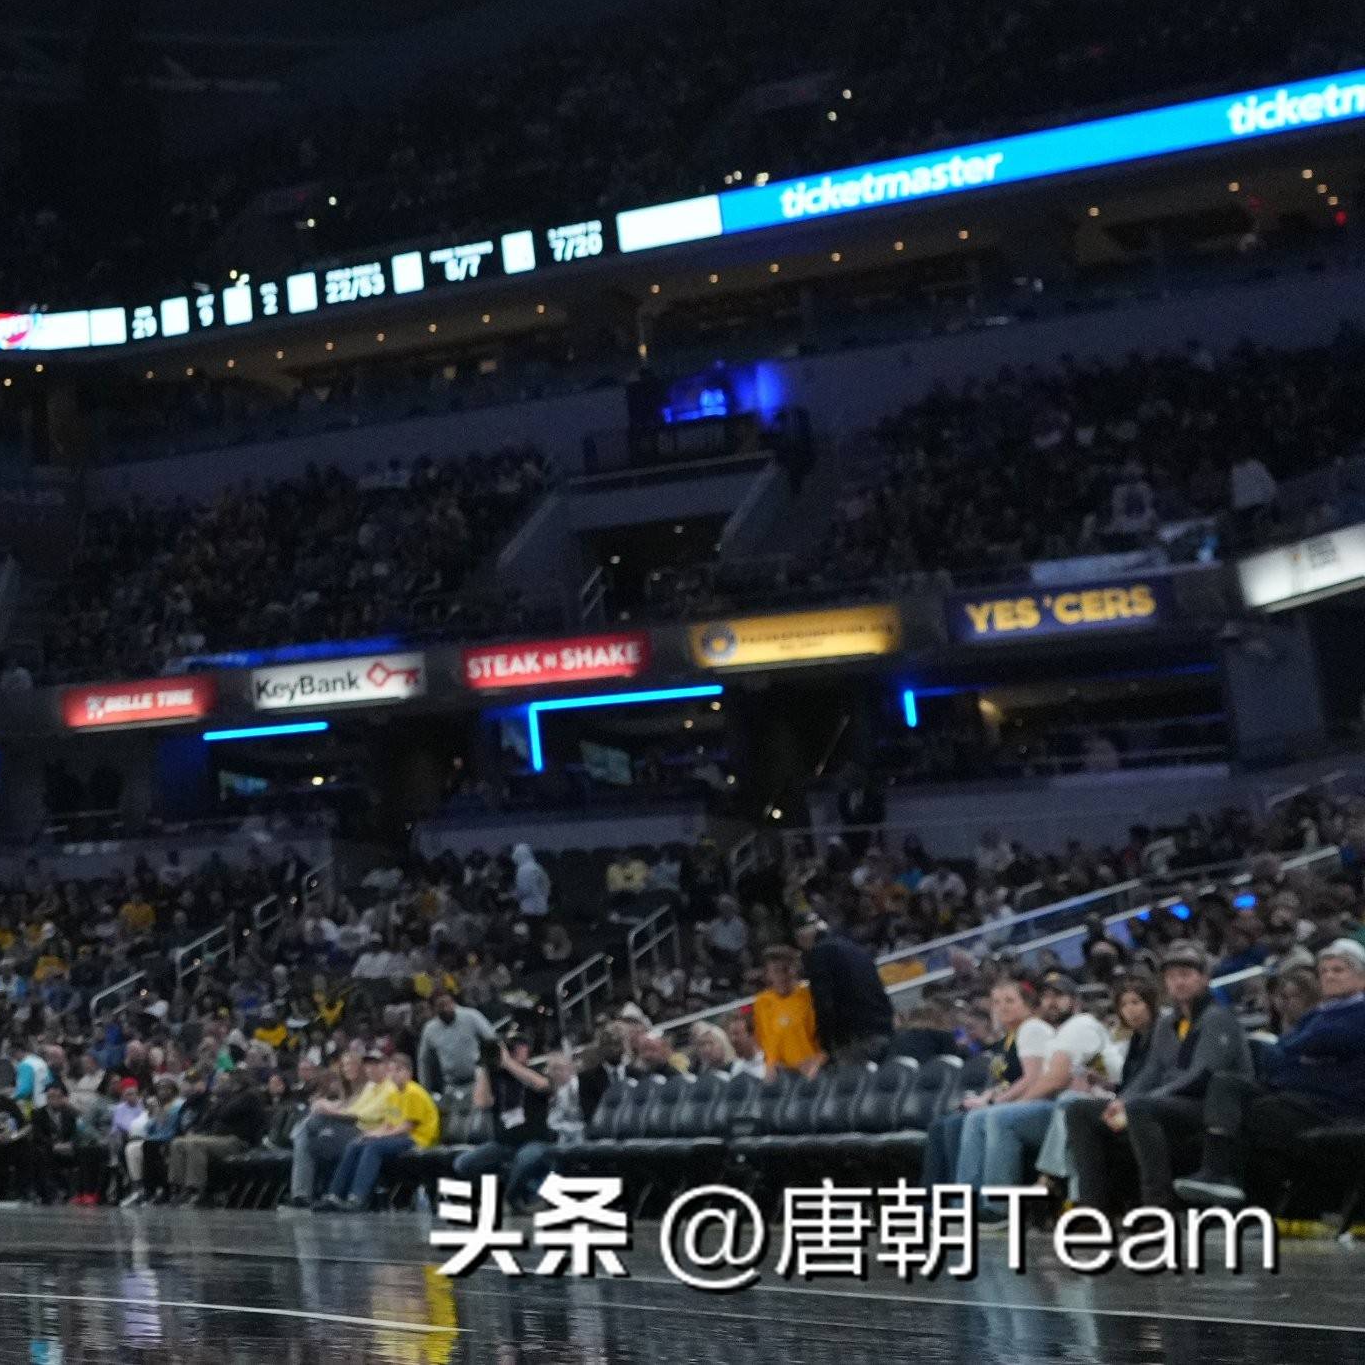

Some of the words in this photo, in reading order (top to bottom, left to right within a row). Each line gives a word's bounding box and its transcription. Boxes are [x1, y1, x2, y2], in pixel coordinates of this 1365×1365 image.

[780, 152, 1004, 219] ticketmaster
[964, 597, 1042, 634] YES
[467, 652, 542, 680] STEAK
[560, 641, 641, 671] SHAKE
[255, 671, 361, 704] KeyBank
